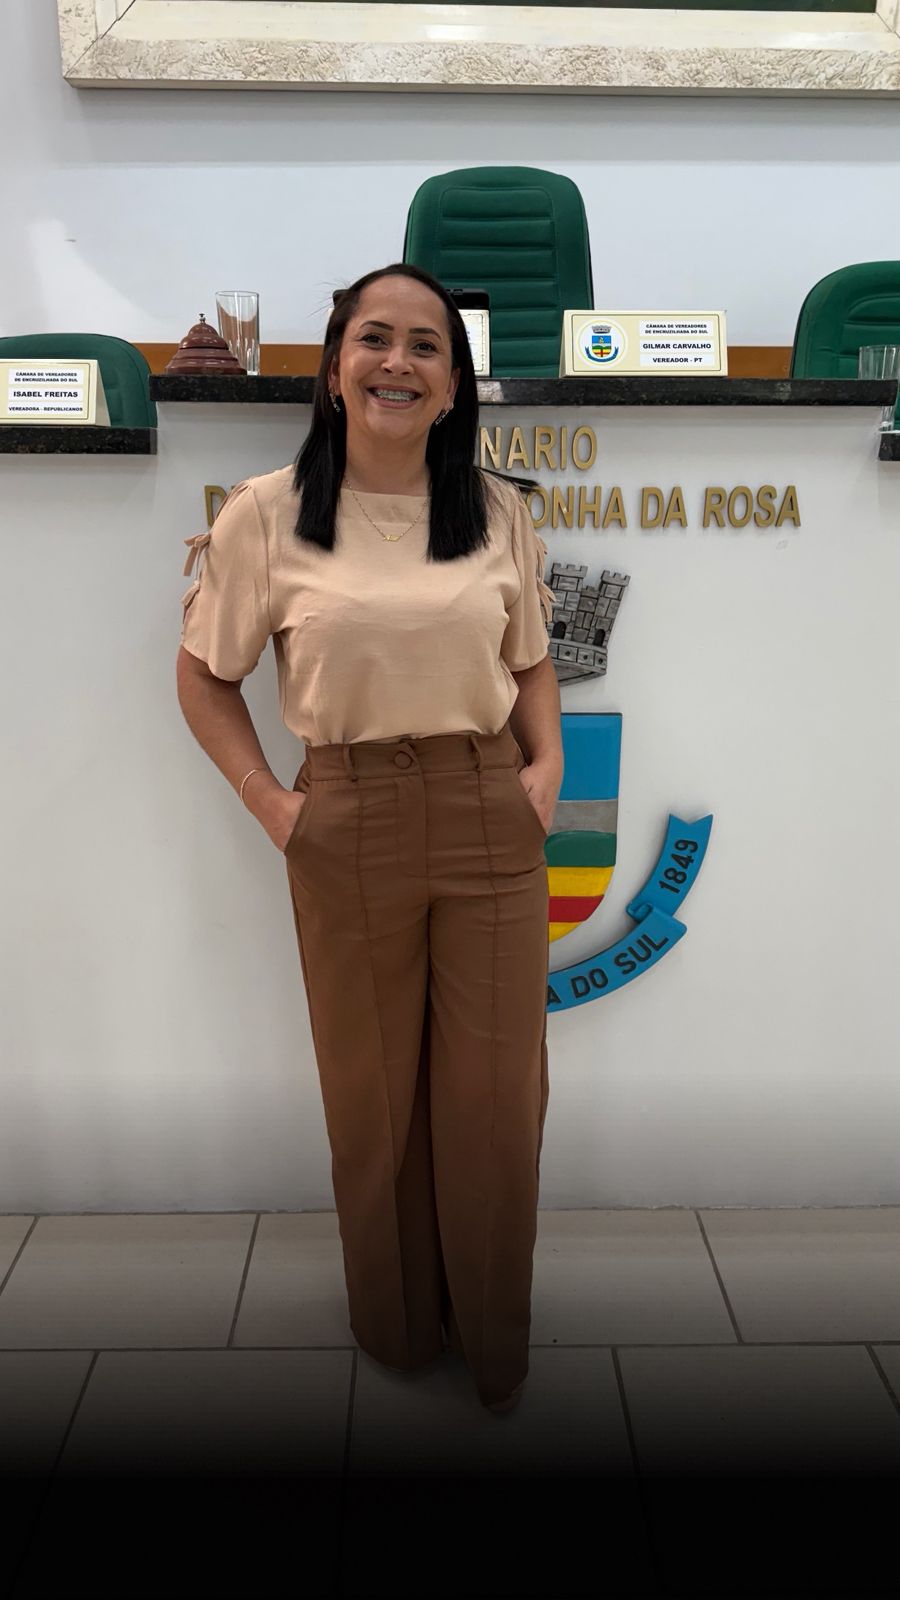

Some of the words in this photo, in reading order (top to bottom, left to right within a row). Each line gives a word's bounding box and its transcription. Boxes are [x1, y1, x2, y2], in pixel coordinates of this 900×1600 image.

[479, 425, 598, 470] NARIO
[526, 486, 627, 528] ONHA
[640, 486, 688, 528] DA
[702, 485, 801, 528] ROSA
[658, 839, 698, 894] 1849
[570, 968, 608, 998] DO
[614, 934, 669, 975] SUL
